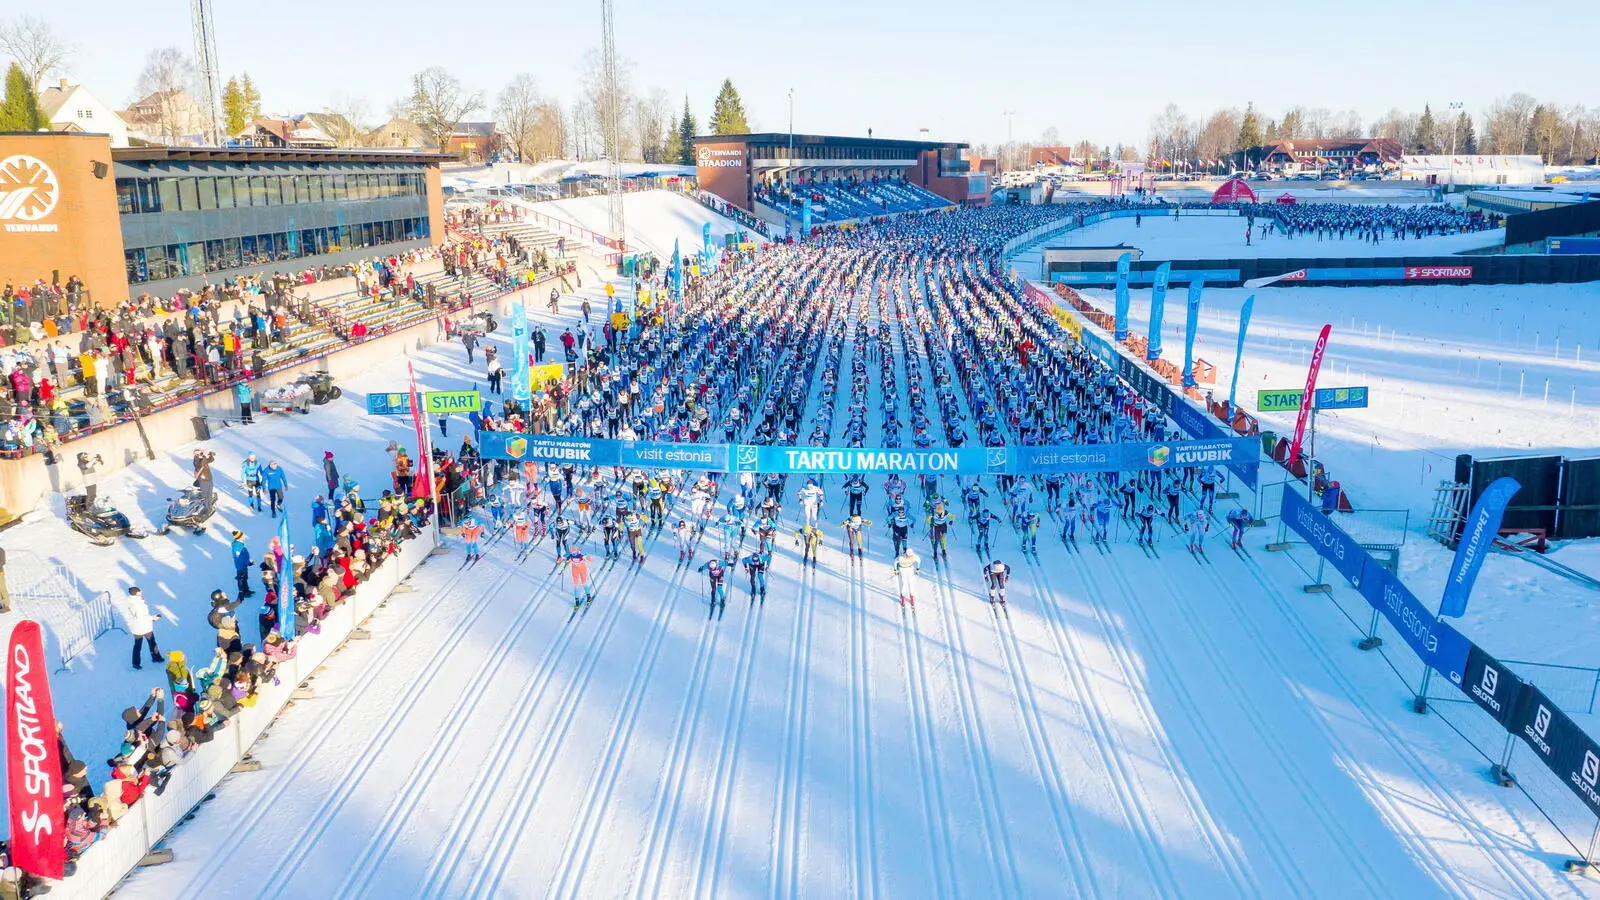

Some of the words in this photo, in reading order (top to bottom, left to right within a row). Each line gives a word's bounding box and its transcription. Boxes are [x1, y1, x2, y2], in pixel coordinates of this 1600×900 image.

[698, 159, 742, 167] STAADION
[1421, 268, 1471, 277] SPORTLAND
[432, 395, 475, 408] START
[533, 446, 592, 461] KUUBIK
[636, 448, 664, 461] visit
[665, 449, 713, 463] estonia
[785, 450, 852, 471] TARTU
[856, 451, 958, 471] MARATON
[1031, 452, 1059, 465] visit
[1060, 451, 1107, 464] estonia
[1175, 449, 1233, 464] KUUBIK
[1296, 505, 1314, 534] visit
[1312, 522, 1346, 561] estonia
[1383, 584, 1404, 617] visit
[1401, 606, 1438, 653] estonia
[1471, 684, 1501, 712] salomon
[14, 643, 50, 798] SPORTLAND
[1524, 724, 1551, 756] salomon
